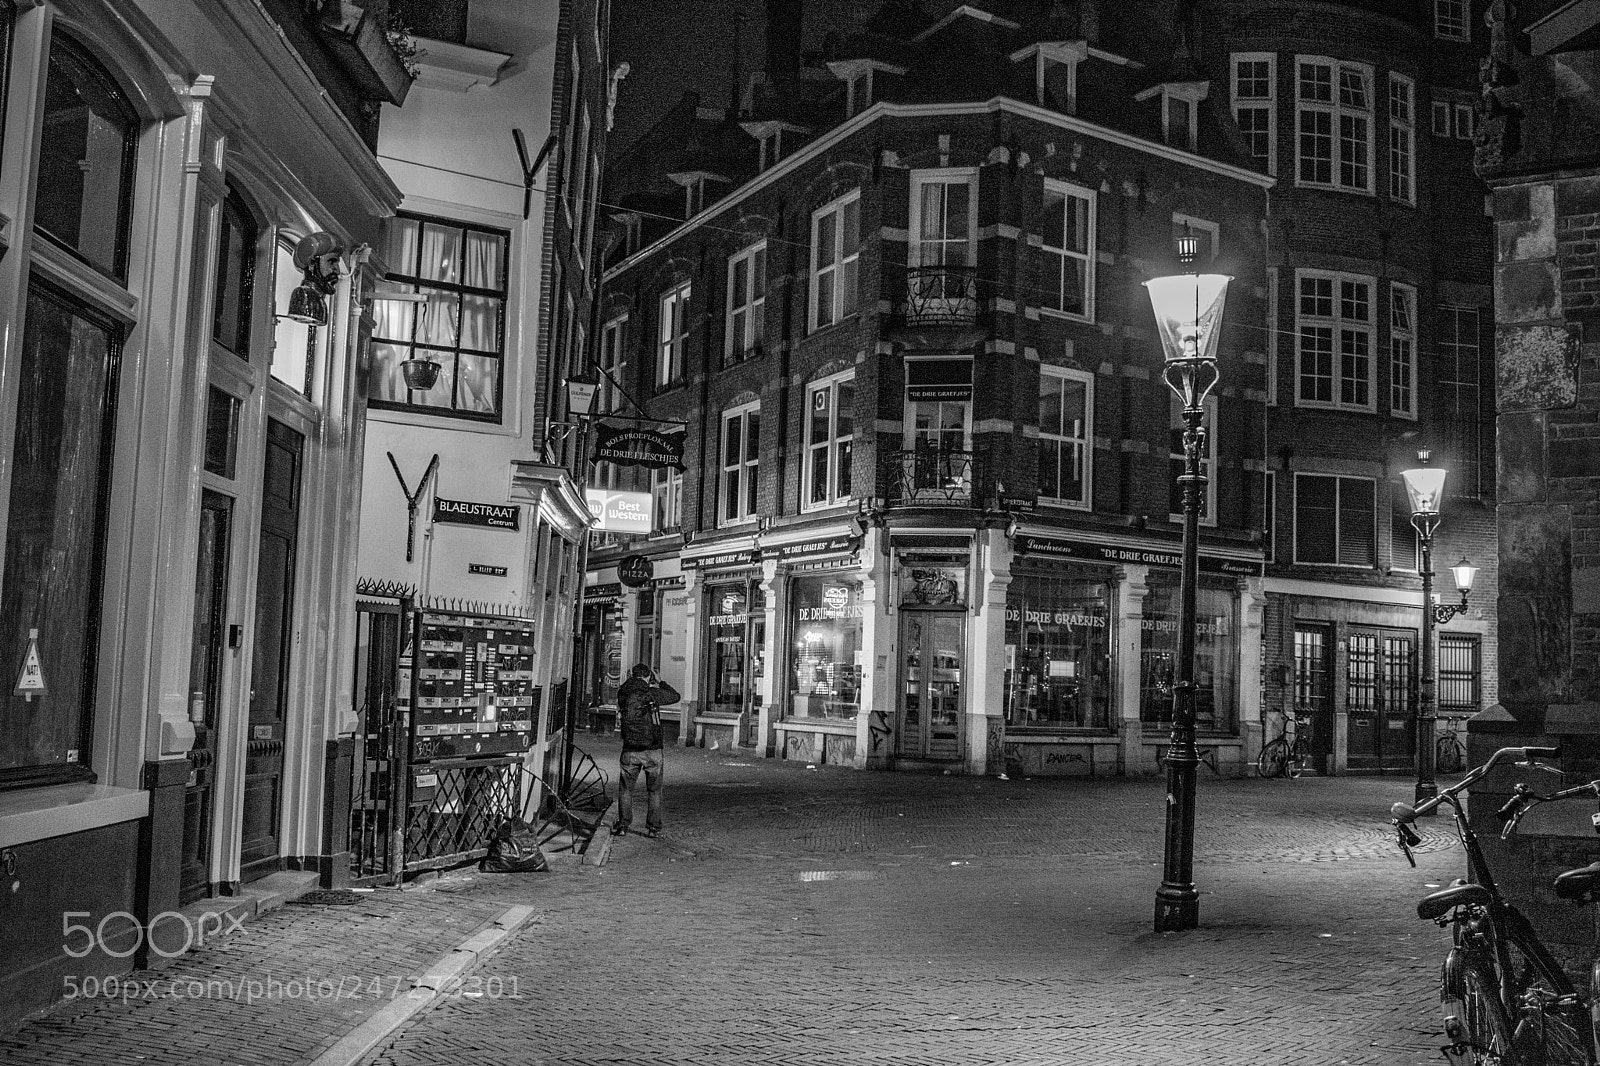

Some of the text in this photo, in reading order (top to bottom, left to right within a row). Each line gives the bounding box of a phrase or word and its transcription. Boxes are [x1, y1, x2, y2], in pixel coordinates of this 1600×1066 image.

[606, 432, 674, 453] BOLS PROEFLOKAAL
[600, 448, 679, 464] DE DRIE FLESCHJES
[440, 501, 515, 518] BLAEUSTRAAT
[618, 501, 640, 512] Best
[608, 509, 649, 521] Western
[488, 518, 514, 527] Centrum
[1026, 539, 1071, 553] Lunchroom
[1119, 550, 1141, 561] DRIE
[622, 570, 649, 578] PIZZA
[709, 615, 716, 626] DE
[799, 608, 810, 620] DE
[811, 608, 828, 621] DRIE
[1006, 609, 1020, 621] DE
[1025, 611, 1051, 632] DRIE
[1141, 620, 1155, 630] DE
[1156, 620, 1178, 635] DRIE
